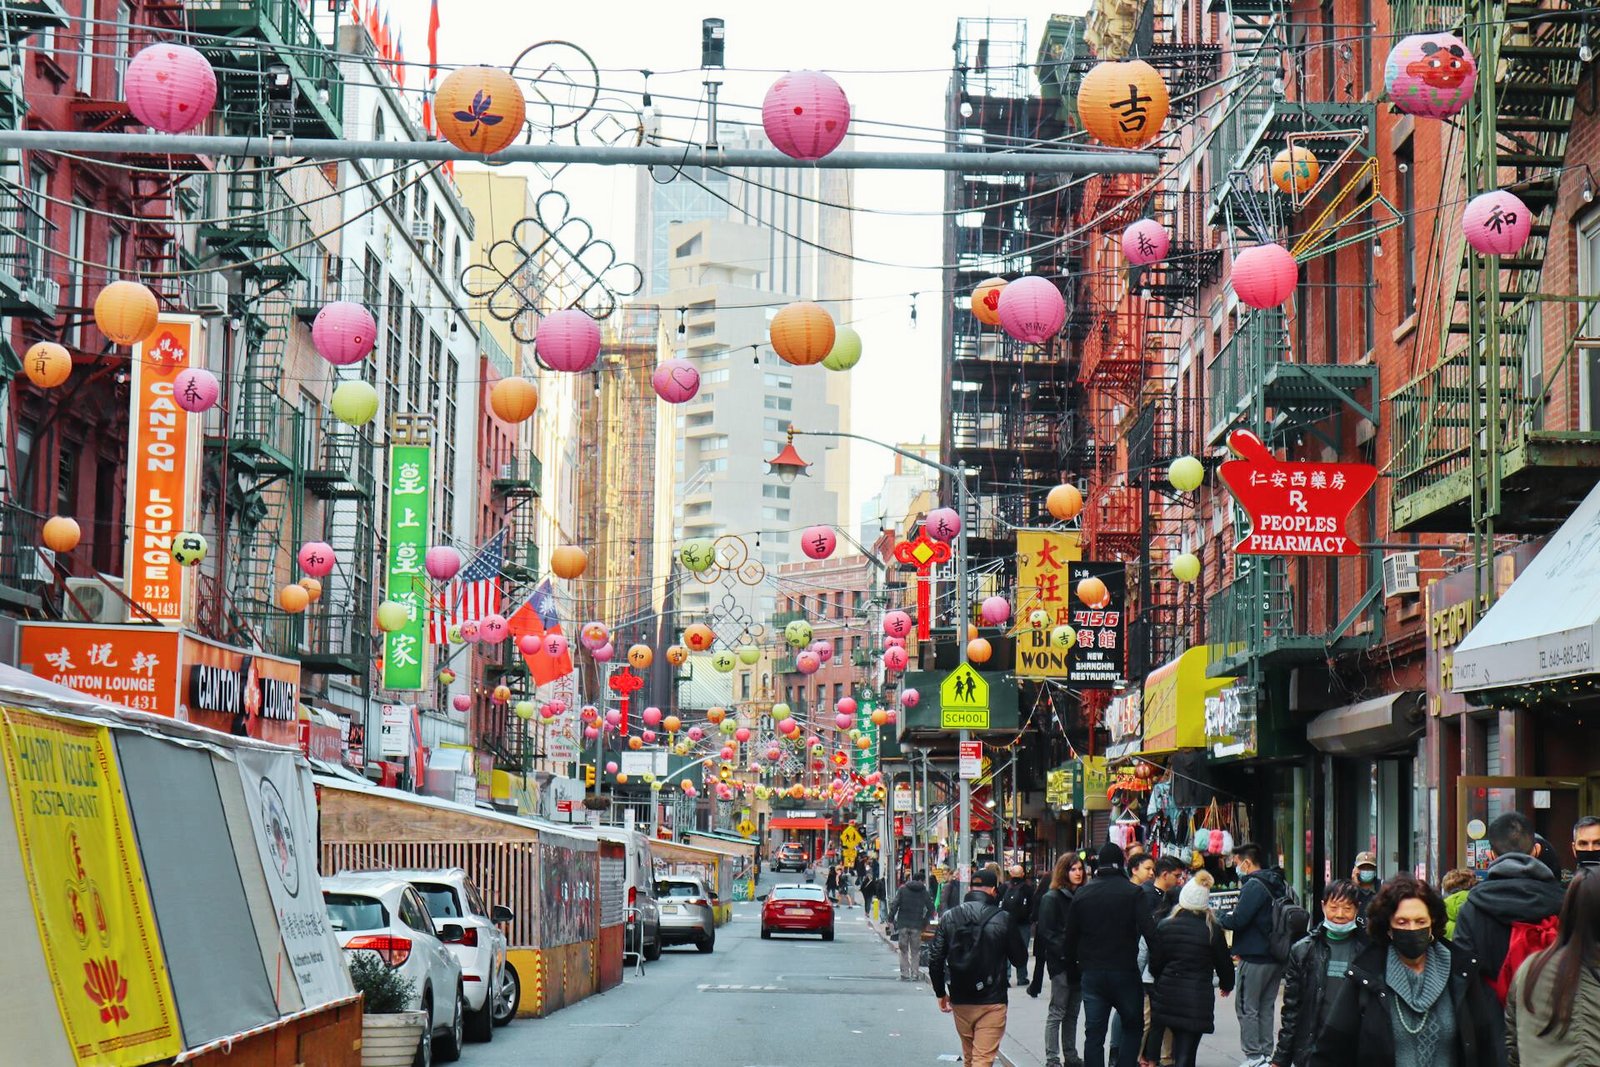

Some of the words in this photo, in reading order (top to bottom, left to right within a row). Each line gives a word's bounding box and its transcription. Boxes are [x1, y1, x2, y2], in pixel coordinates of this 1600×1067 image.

[1109, 83, 1153, 133] 吉
[1483, 204, 1518, 235] 和
[1137, 231, 1158, 257] 春
[32, 348, 52, 376] 貴
[182, 376, 203, 404] 春
[147, 382, 177, 472] CANTON
[1249, 469, 1347, 491] 仁安西藥房
[935, 517, 954, 537] 春
[1260, 514, 1338, 533] PEOPLES
[143, 488, 174, 580] LOUNGE
[812, 534, 828, 553] 吉
[1250, 534, 1347, 553] PHARMACY
[306, 551, 325, 567] 和
[144, 585, 170, 599] 212
[486, 621, 501, 631] 和
[893, 617, 905, 632] 吉
[1075, 611, 1120, 627] 456
[548, 640, 560, 654] 吉
[1058, 631, 1070, 646] 吉
[1077, 628, 1117, 648] 餐館
[1086, 652, 1104, 661] NEW
[1075, 662, 1115, 671] SHANGHAI
[52, 673, 102, 690] CANTON
[105, 675, 155, 693] LOUNGE
[1070, 672, 1121, 681] RESTAURANT
[199, 664, 241, 714] CANTON
[263, 678, 296, 721] LOUNGE
[945, 713, 985, 724] SCHOOL
[17, 735, 58, 783] HAPPY
[59, 742, 98, 787] VEGGIE
[31, 789, 100, 819] RESTAURANT
